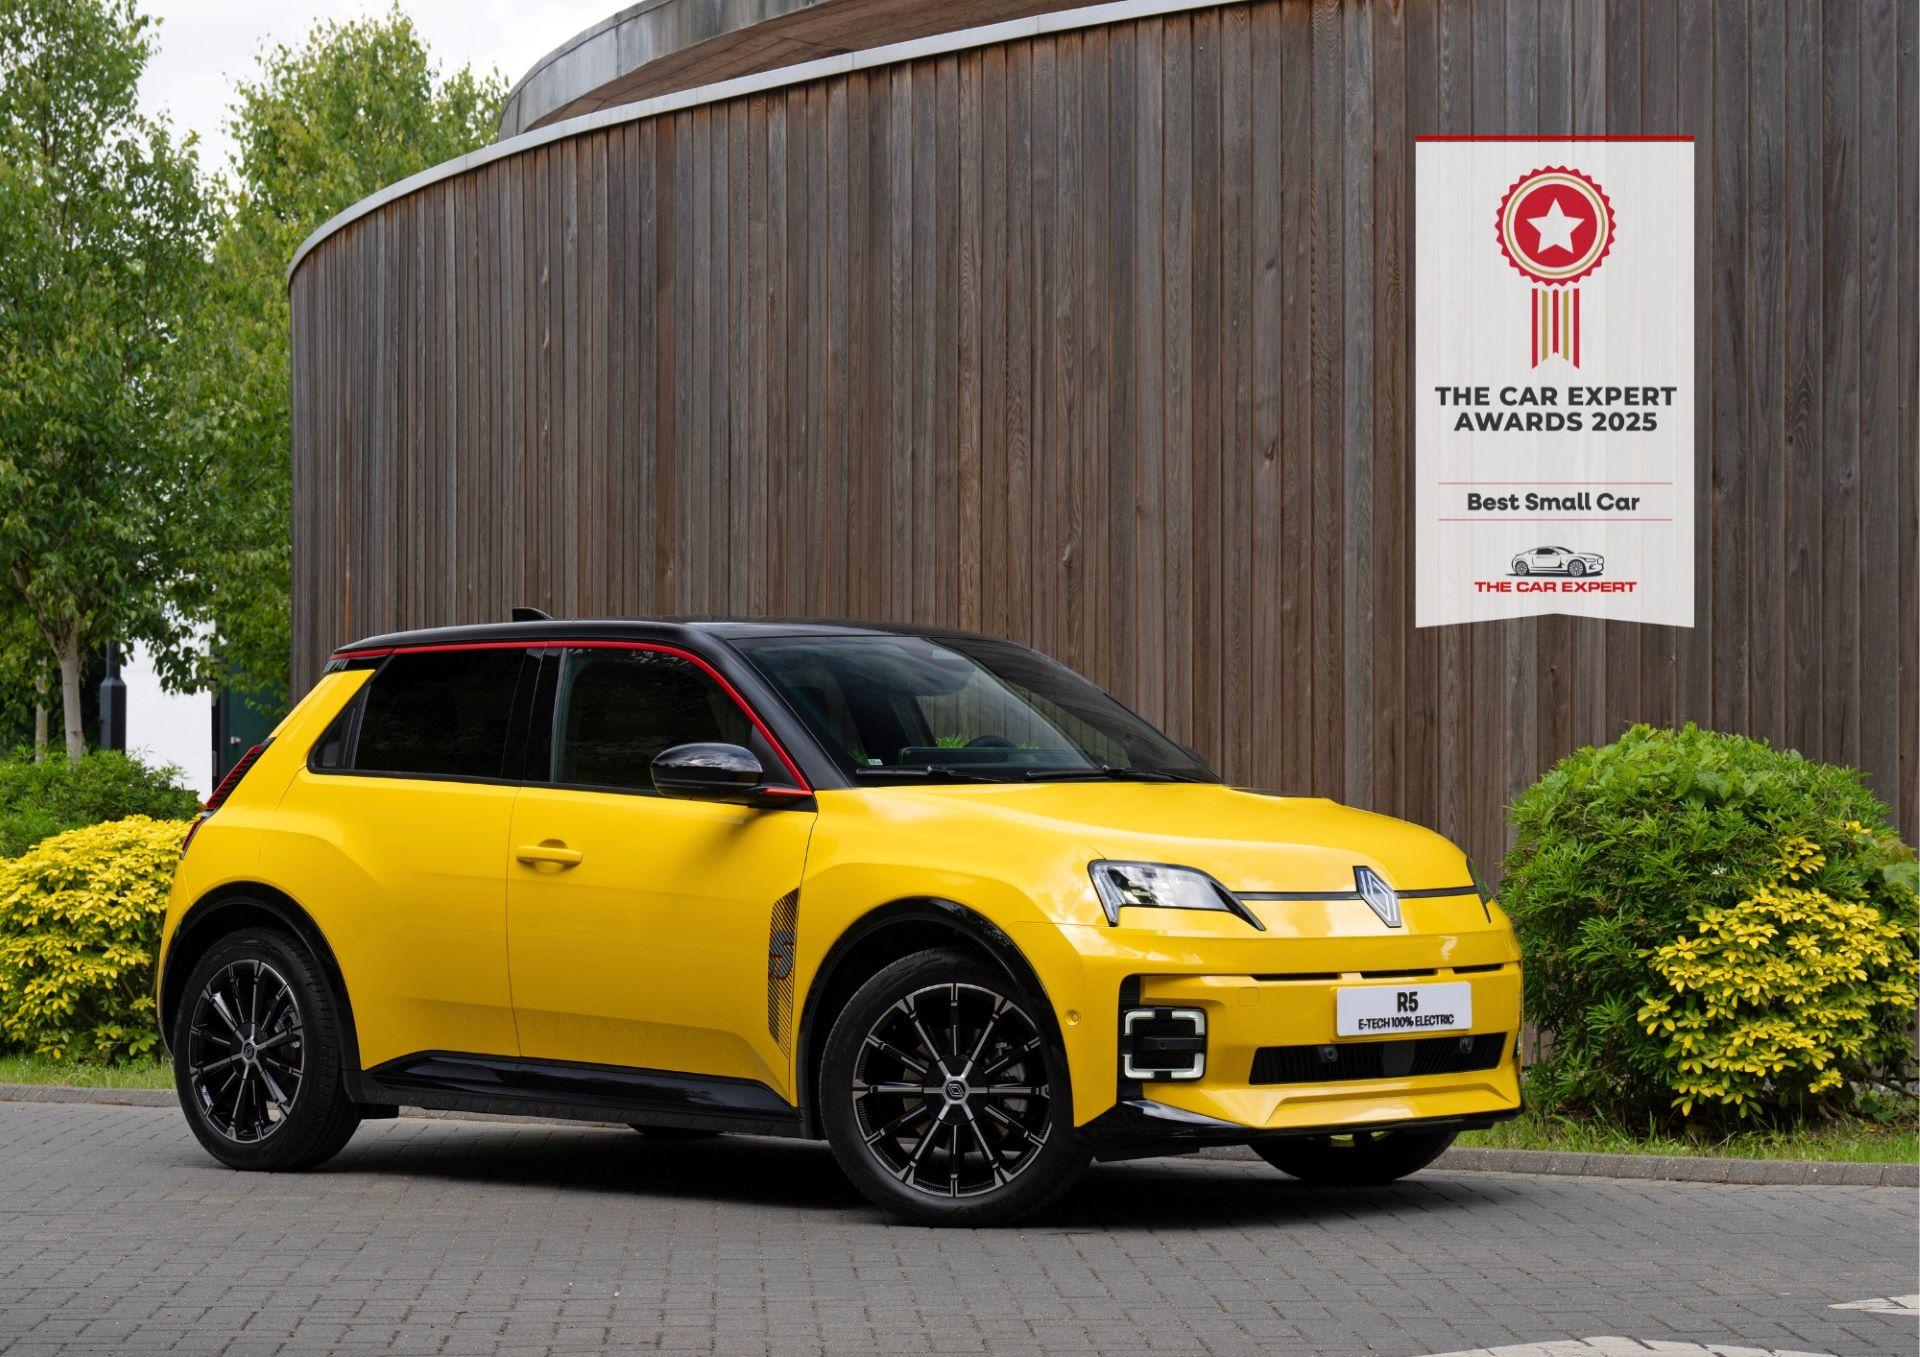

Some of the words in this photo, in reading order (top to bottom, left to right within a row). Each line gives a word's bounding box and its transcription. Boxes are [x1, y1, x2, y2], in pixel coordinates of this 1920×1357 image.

[1397, 991, 1419, 1012] R5
[1358, 1017, 1391, 1030] E-TECH
[1391, 1015, 1414, 1028] 100%
[1415, 1013, 1455, 1026] ELECTRIC
